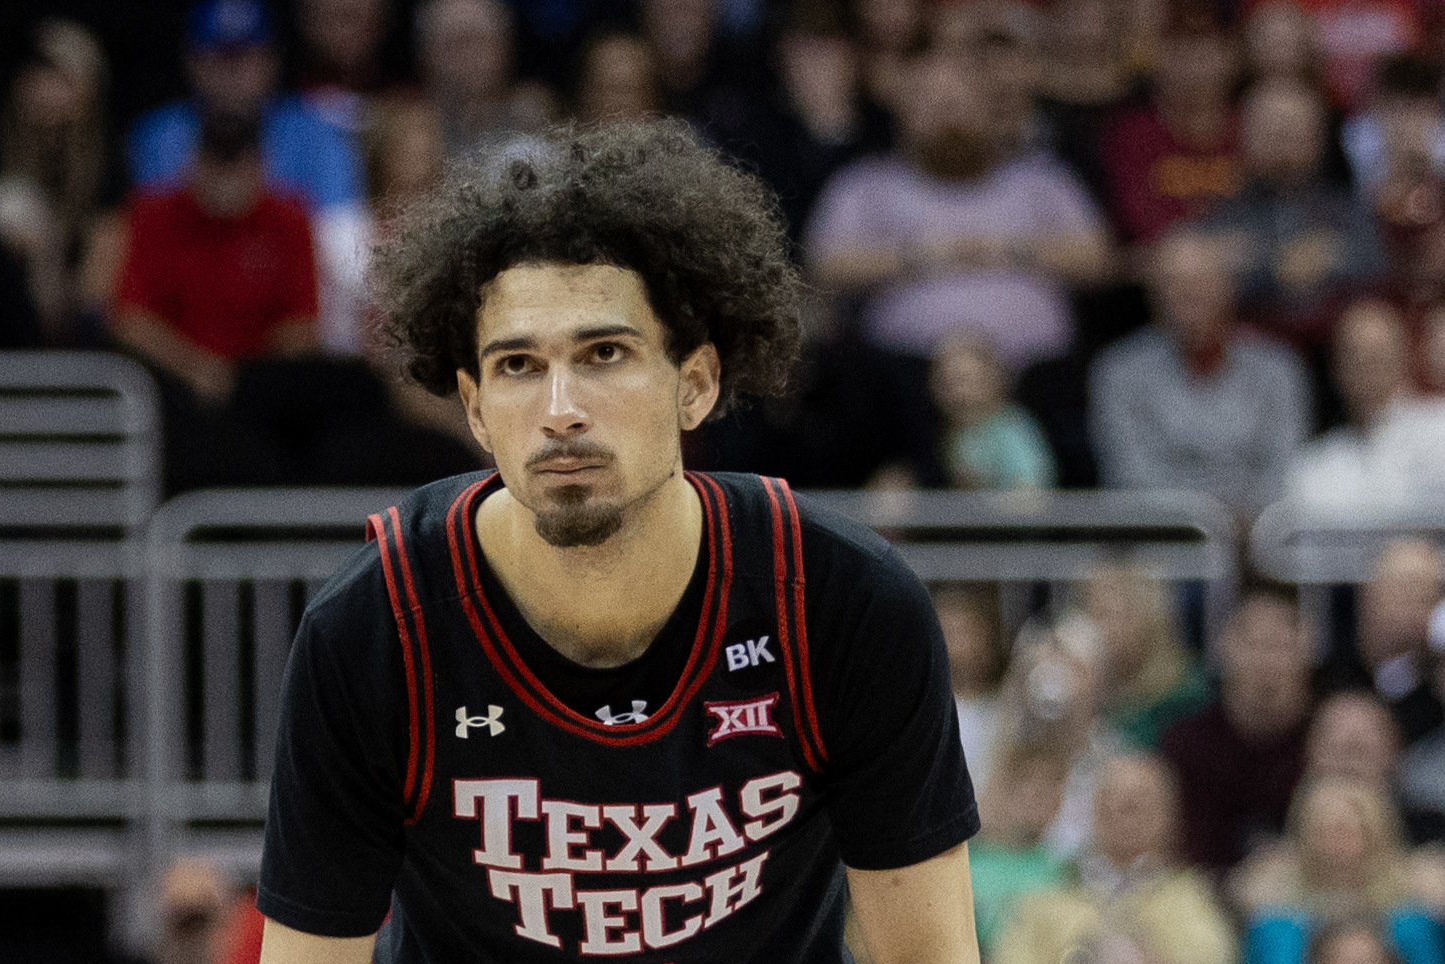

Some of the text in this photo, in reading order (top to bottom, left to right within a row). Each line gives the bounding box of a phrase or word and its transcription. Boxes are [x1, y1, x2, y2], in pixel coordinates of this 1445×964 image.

[725, 635, 776, 672] BK
[708, 697, 779, 741] XII
[452, 770, 803, 873] TEXAS
[487, 850, 770, 957] TECH
